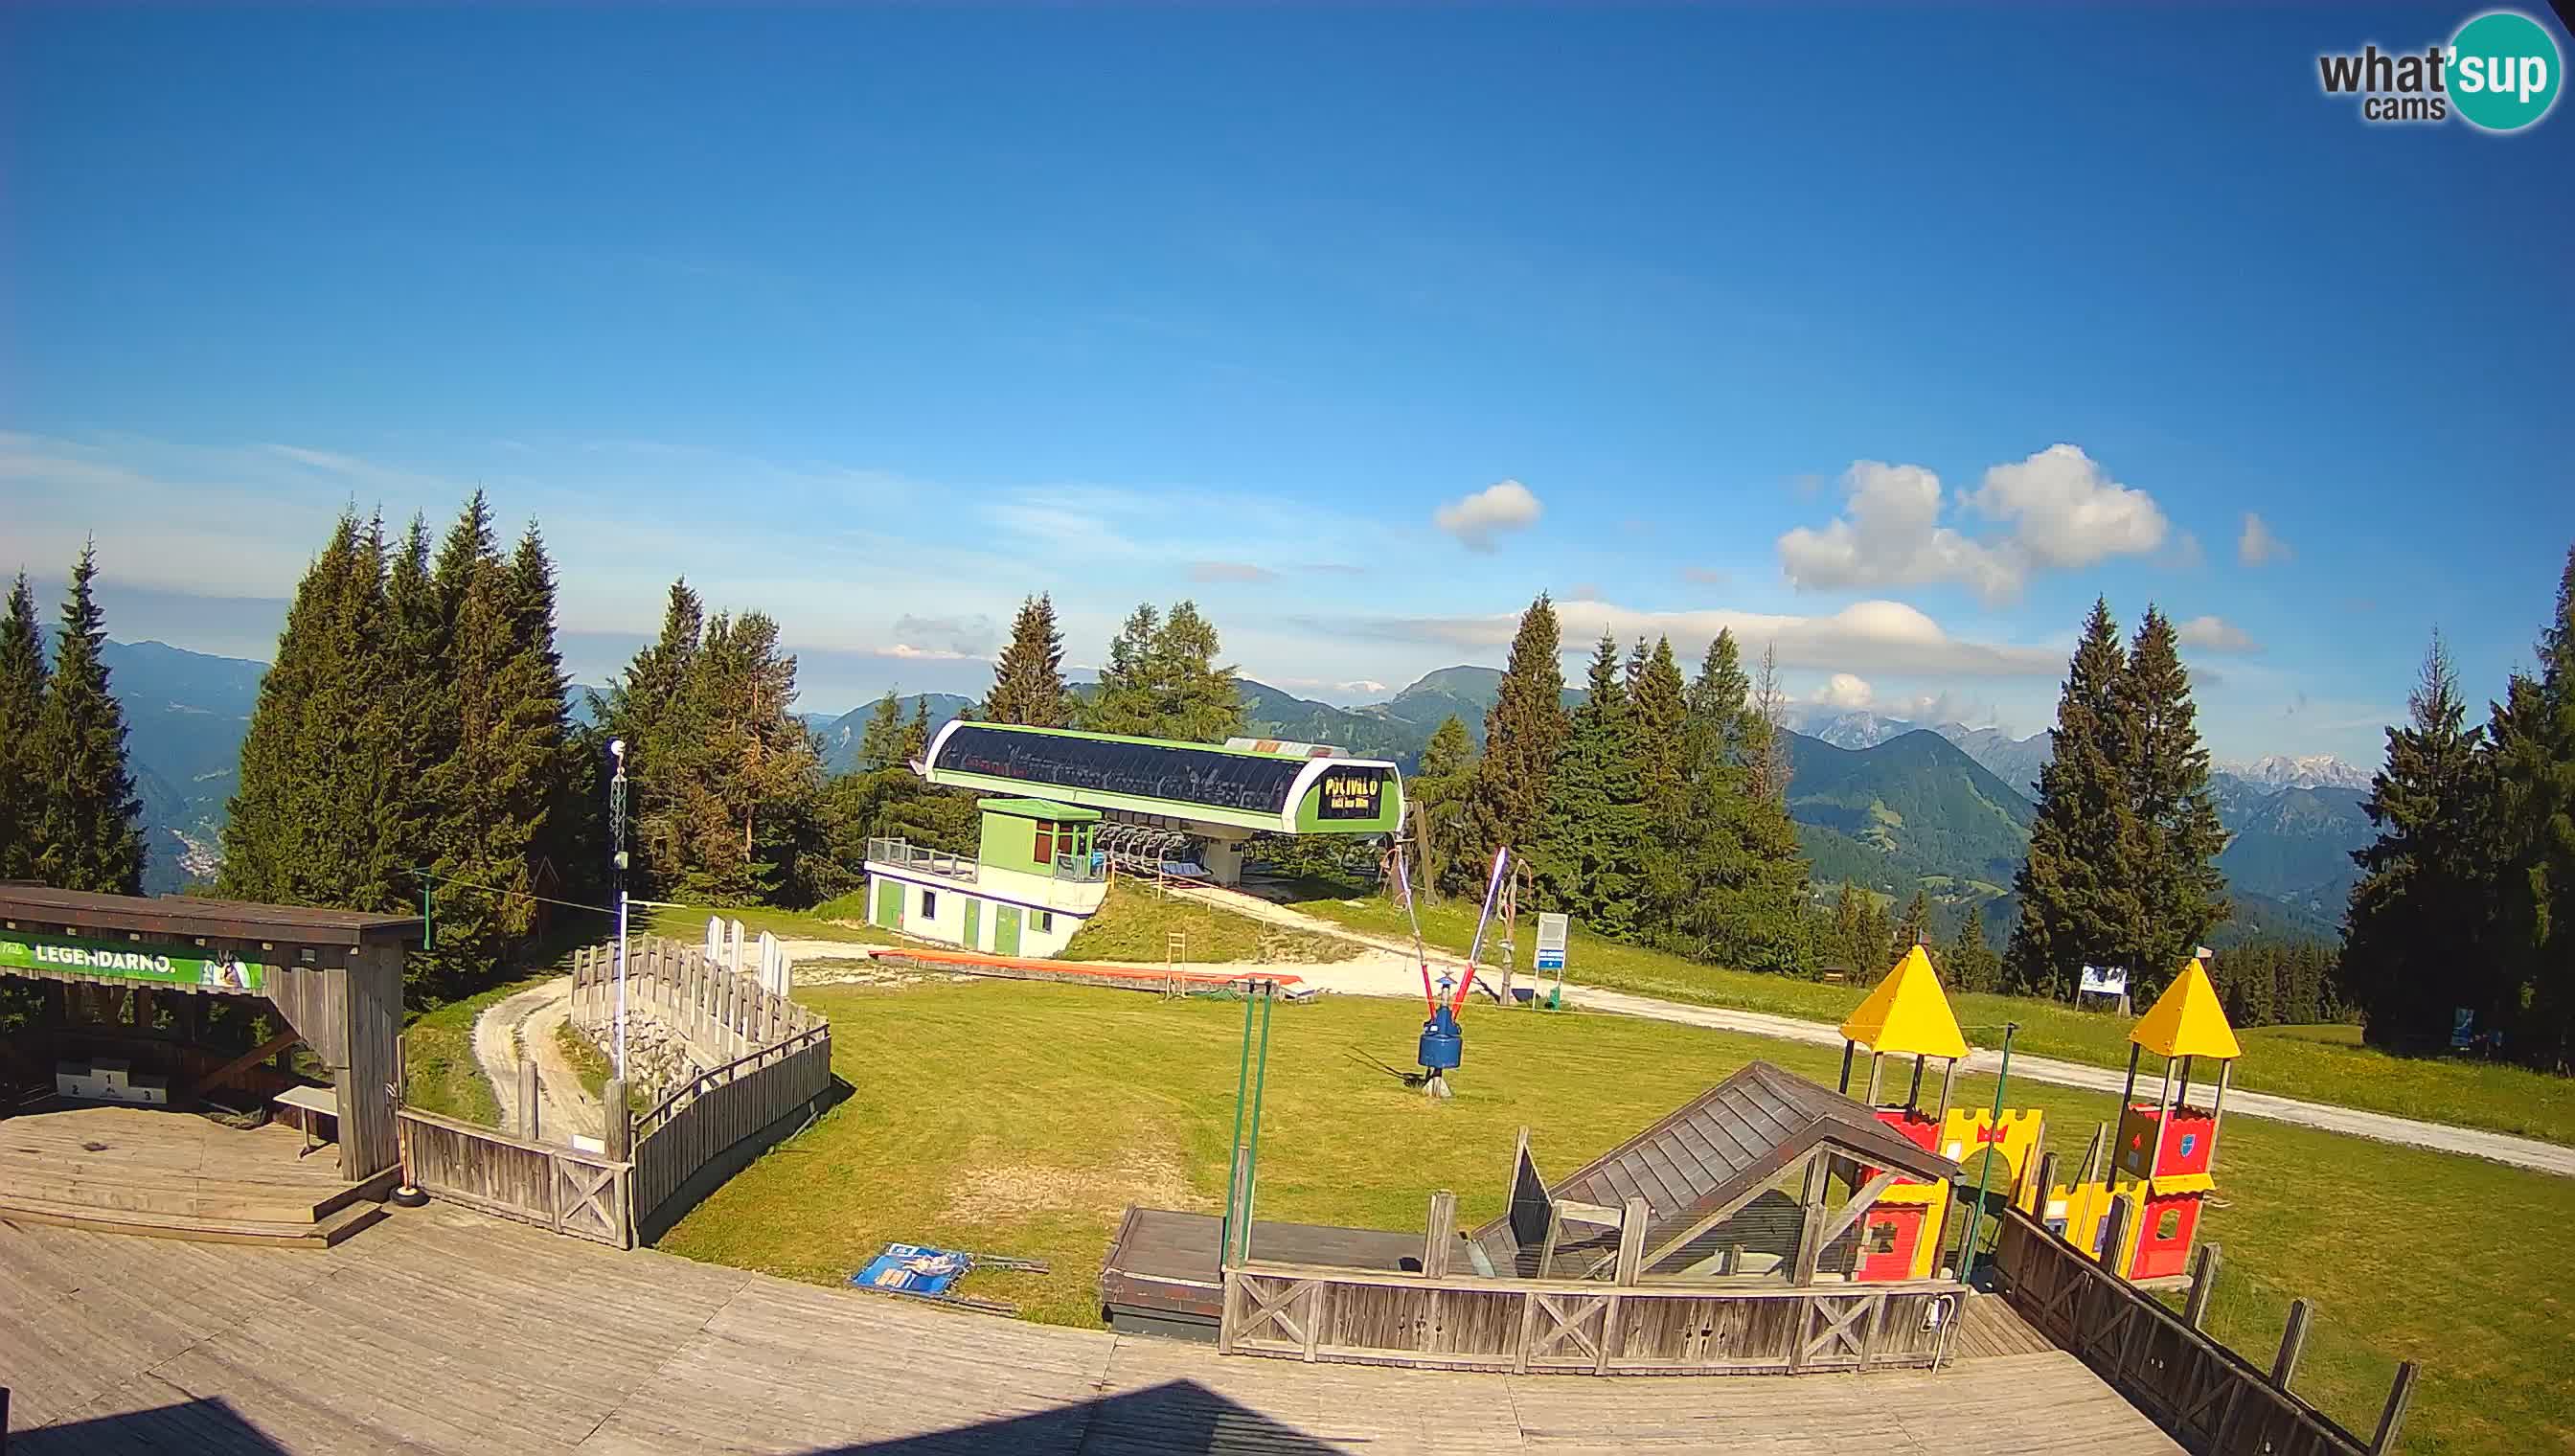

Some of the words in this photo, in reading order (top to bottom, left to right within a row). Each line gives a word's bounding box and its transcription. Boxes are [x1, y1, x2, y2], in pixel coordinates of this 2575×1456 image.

[35, 944, 176, 974] LEGENDARNO.
[105, 1073, 112, 1084] 1
[71, 1084, 80, 1095] 2
[144, 1090, 151, 1101] 3
